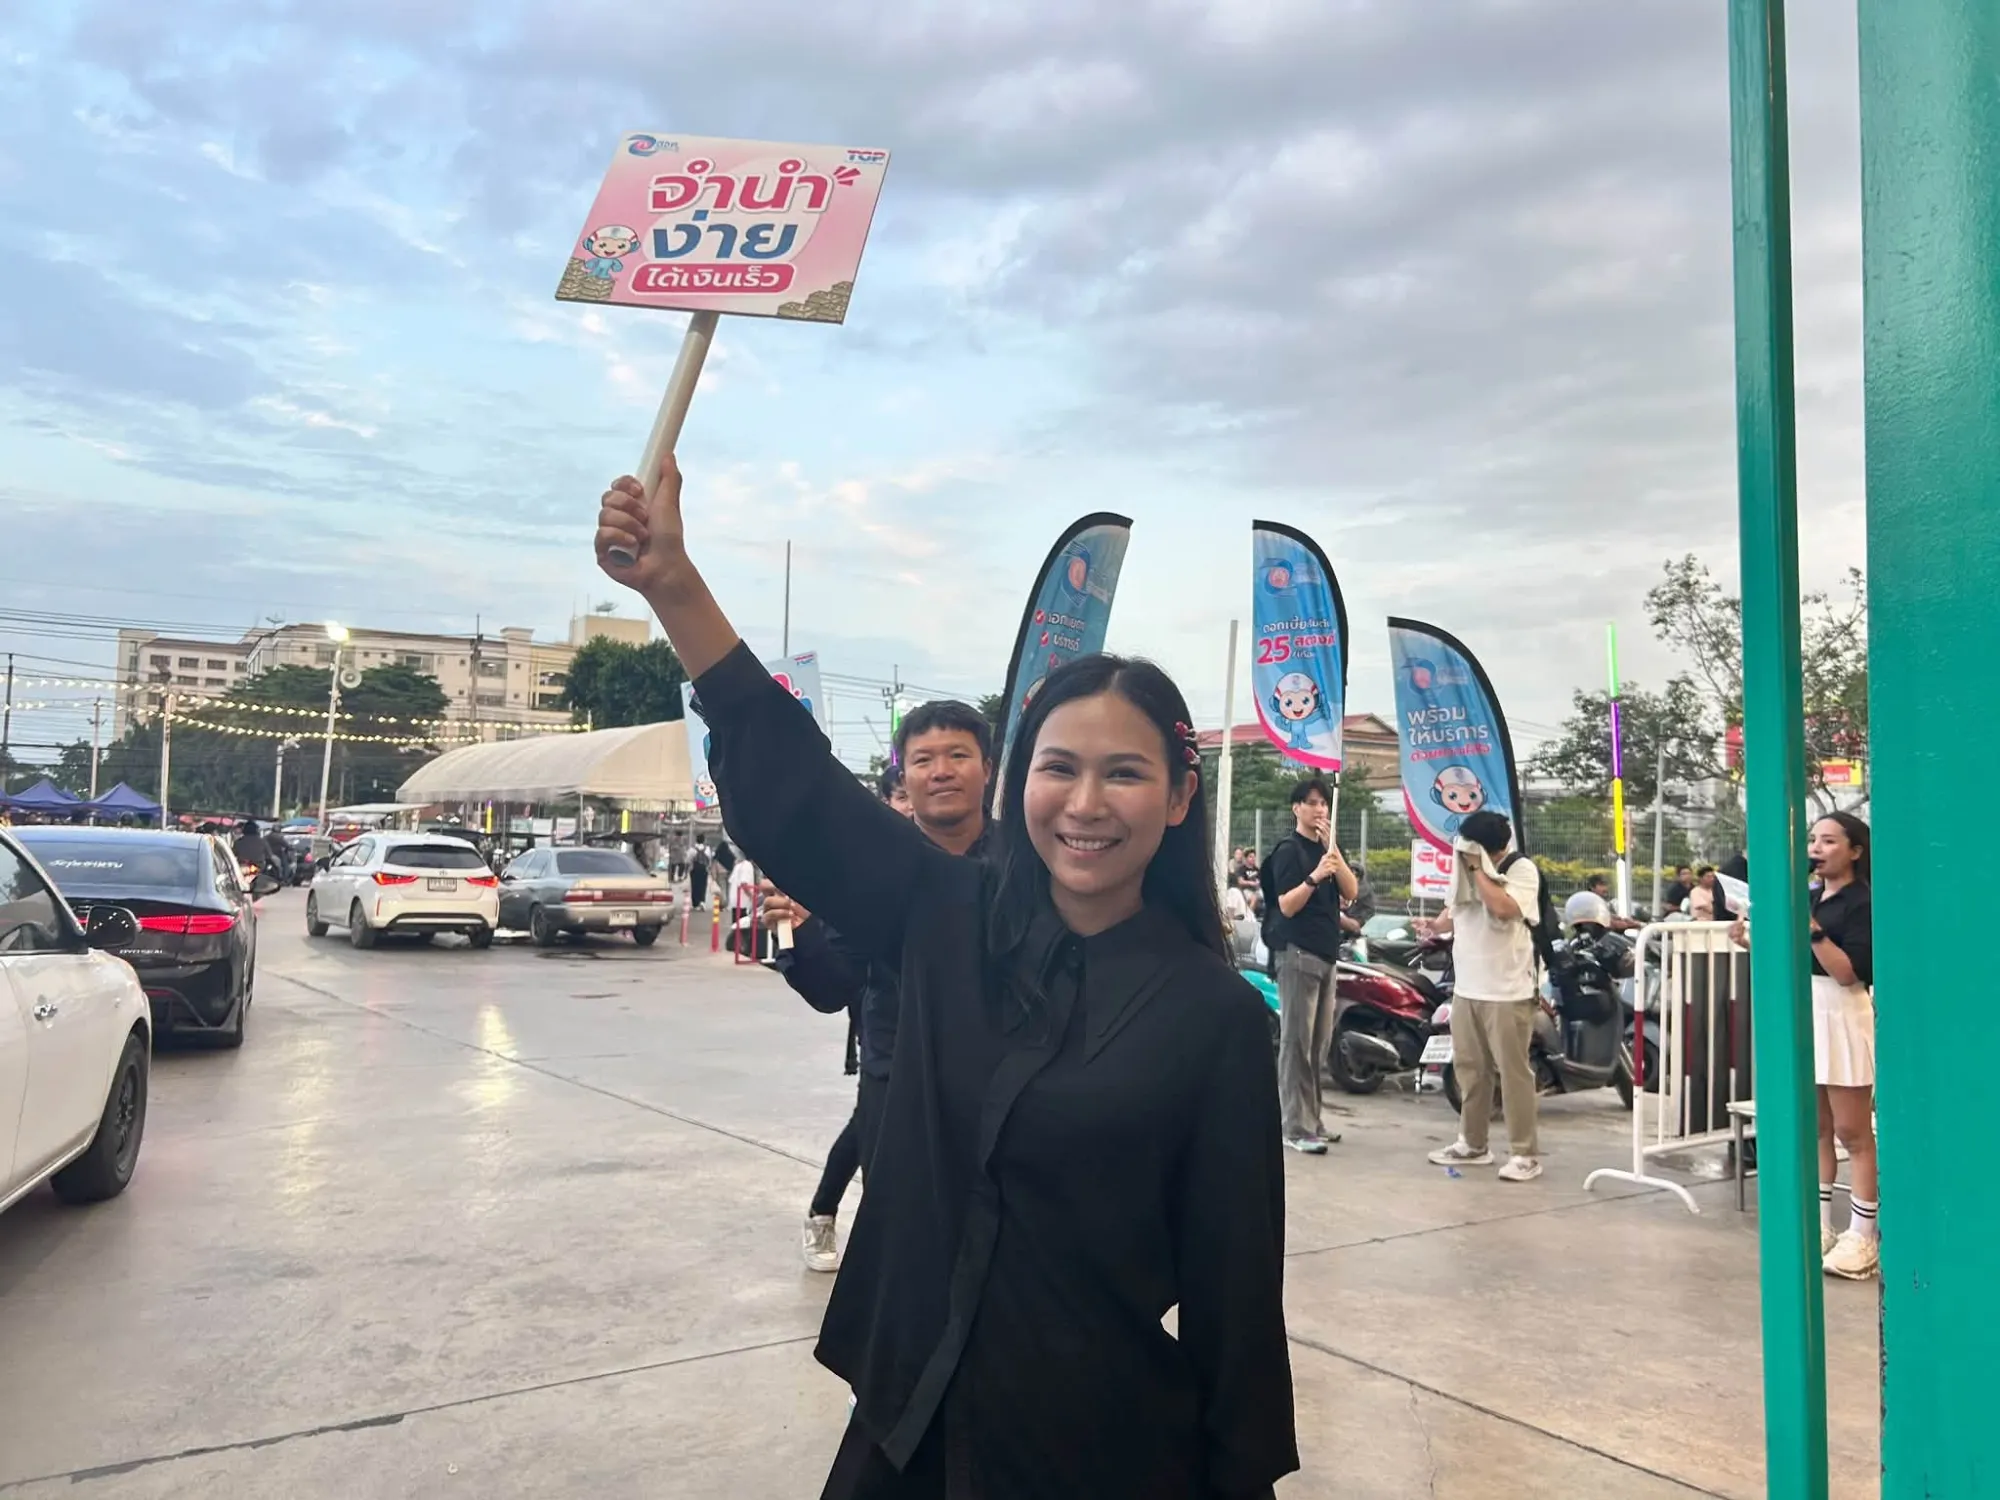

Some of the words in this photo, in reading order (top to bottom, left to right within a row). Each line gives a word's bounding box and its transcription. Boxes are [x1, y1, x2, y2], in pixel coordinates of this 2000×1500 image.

[651, 158, 830, 211] จำนำ
[652, 209, 799, 259] ง่าย
[645, 265, 781, 288] ได้เงินเร็ว
[1257, 633, 1292, 664] 25
[1406, 703, 1467, 726] พร้อม
[1407, 724, 1489, 746] ให้บริการ
